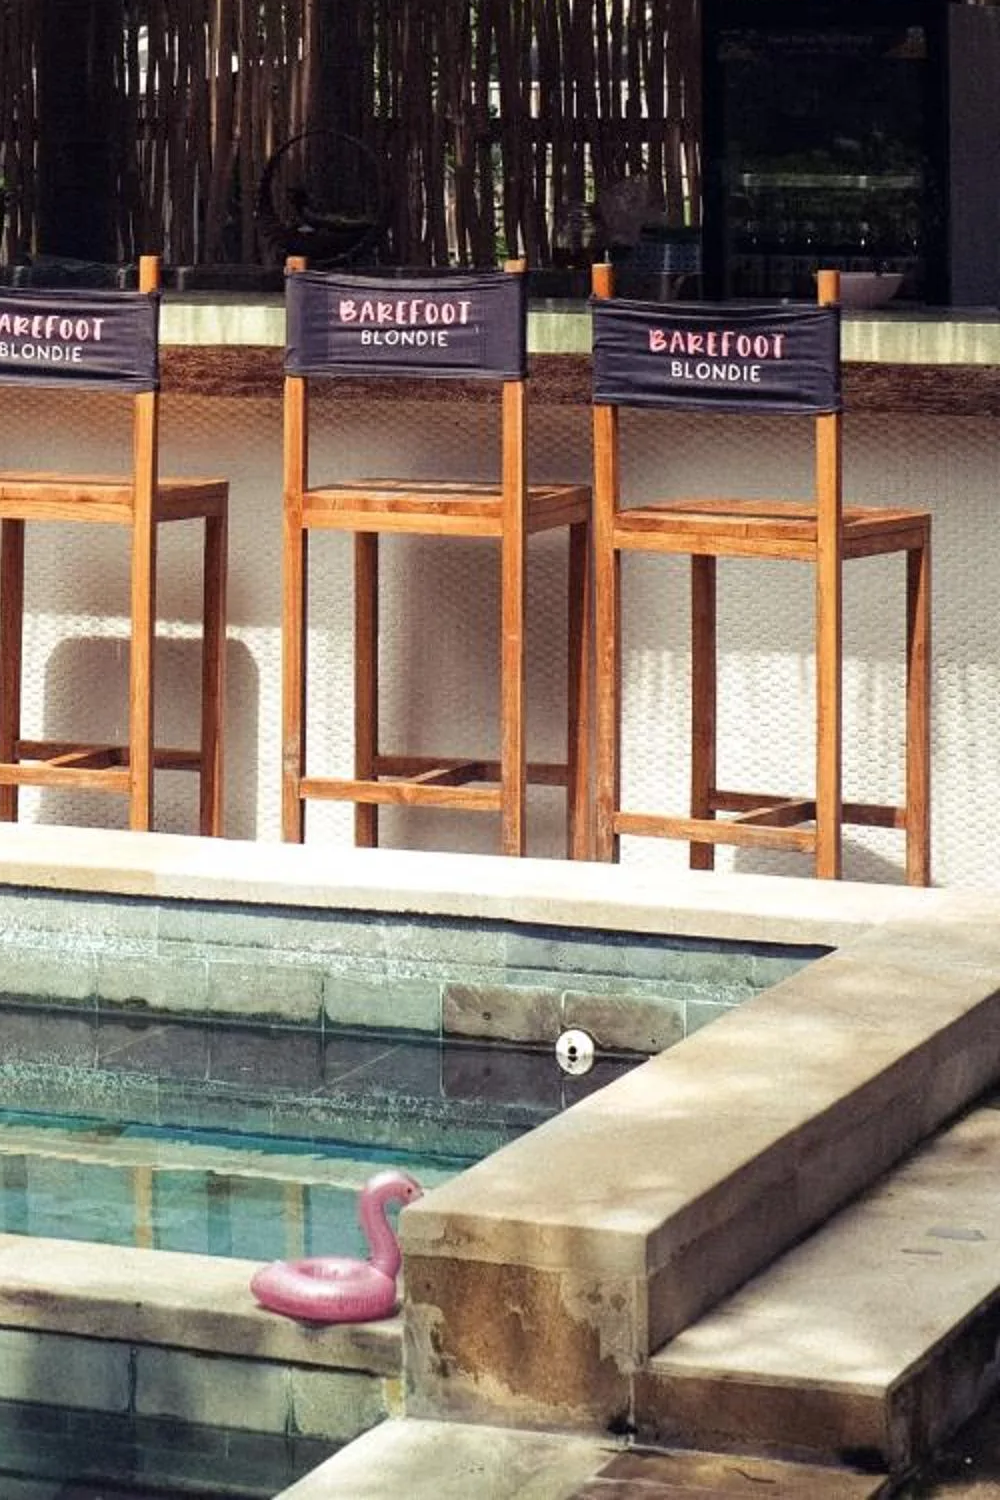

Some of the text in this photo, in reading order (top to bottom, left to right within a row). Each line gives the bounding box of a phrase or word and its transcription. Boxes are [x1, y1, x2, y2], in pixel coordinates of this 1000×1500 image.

[340, 299, 472, 325] BAREFOOT
[361, 329, 449, 347] BLONDIE
[649, 329, 785, 358] BAREFOOT
[671, 361, 761, 383] BLONDIE
